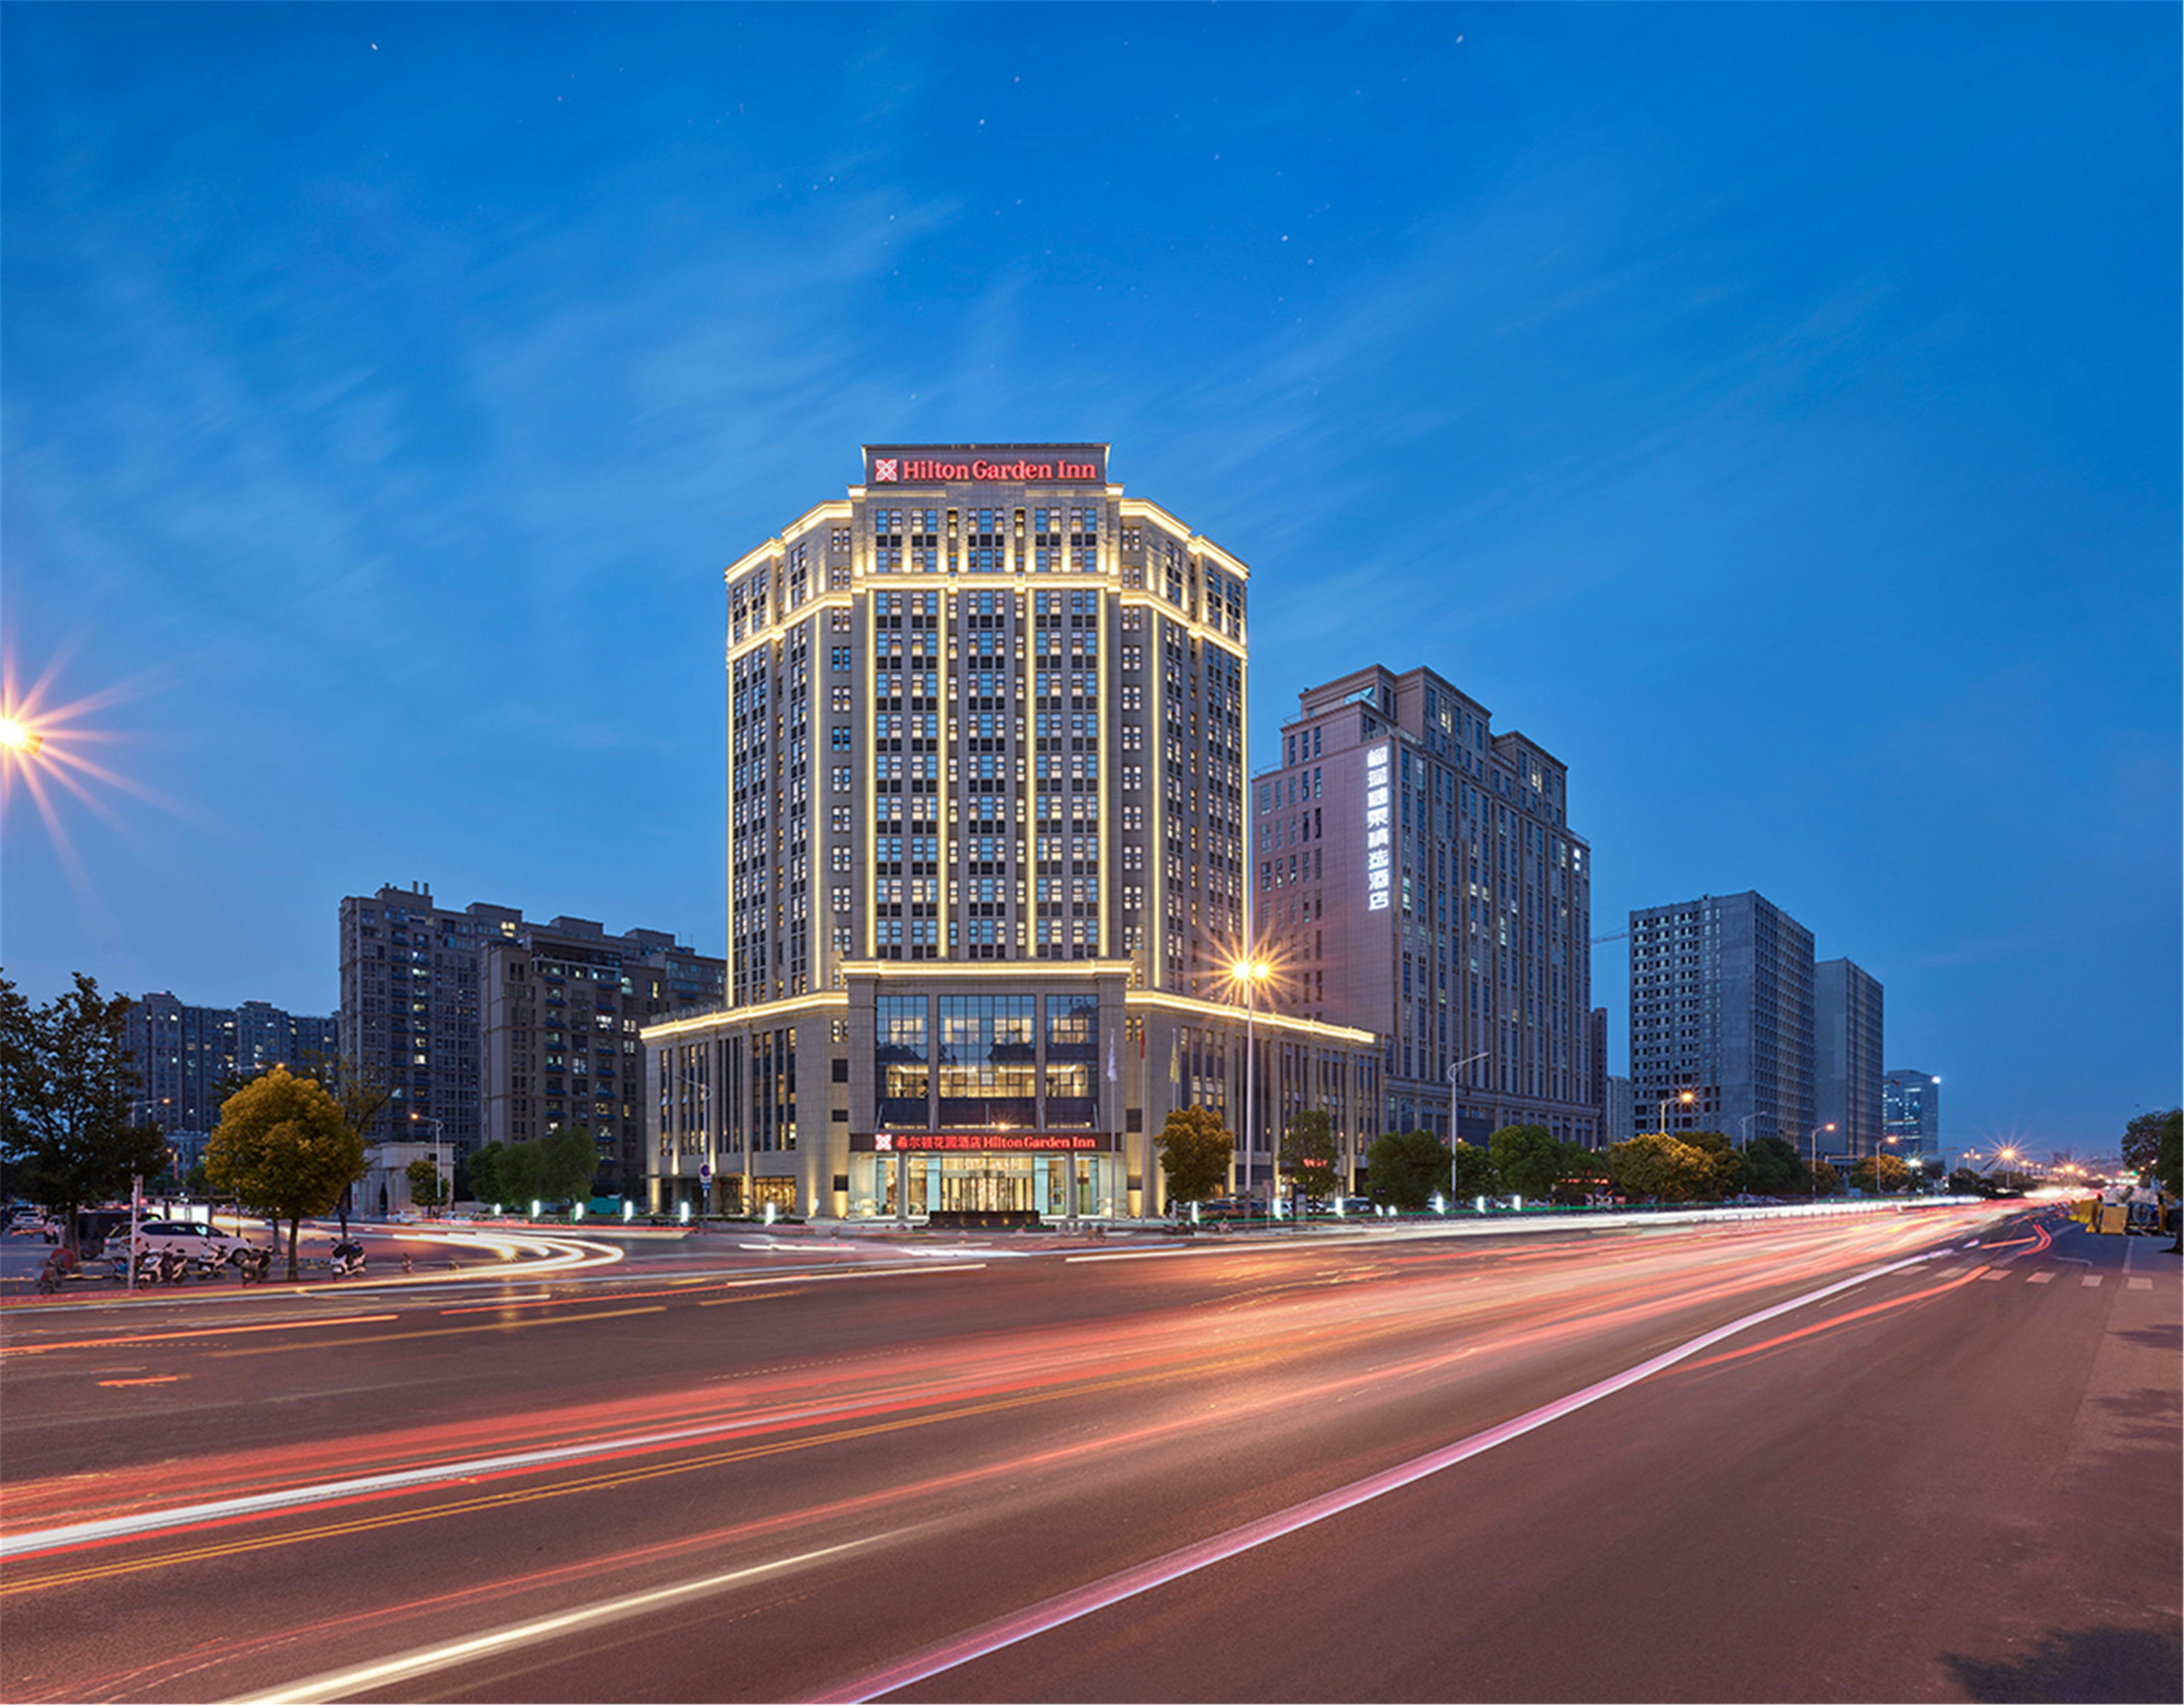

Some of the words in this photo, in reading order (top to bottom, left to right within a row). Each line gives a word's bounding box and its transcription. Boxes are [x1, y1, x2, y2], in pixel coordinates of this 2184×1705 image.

[902, 460, 969, 480] Hilton
[971, 459, 1052, 480] Garden
[1057, 460, 1097, 479] Inn
[983, 1136, 1023, 1149] Hilton
[1024, 1136, 1071, 1149] Garden
[1072, 1136, 1096, 1149] Inn
